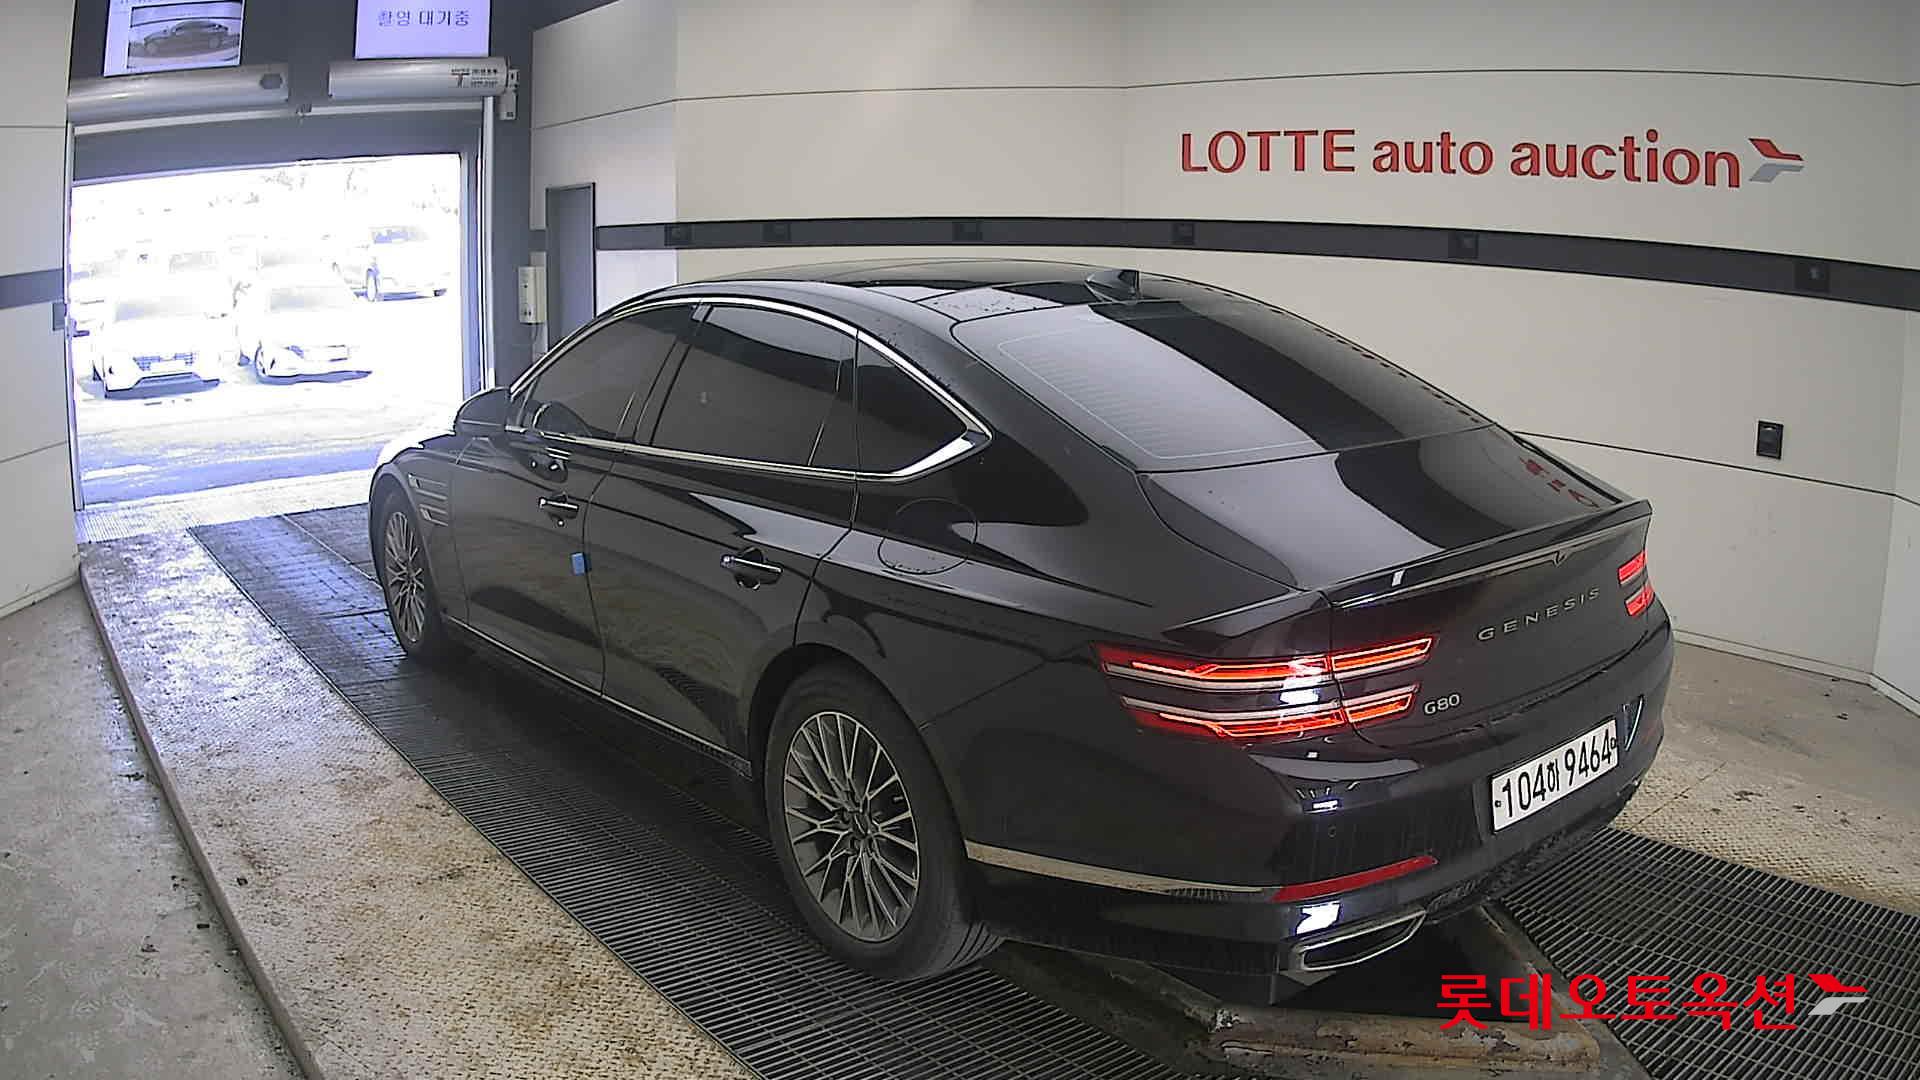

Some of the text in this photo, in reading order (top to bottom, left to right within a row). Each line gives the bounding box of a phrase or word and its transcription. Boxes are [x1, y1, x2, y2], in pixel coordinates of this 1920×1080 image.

[419, 10, 469, 27] 대기중
[1181, 128, 1741, 189] LOTTE auto auction
[1477, 587, 1600, 641] GENESIS
[1424, 693, 1461, 715] G80
[1502, 728, 1613, 818] 104하 9464
